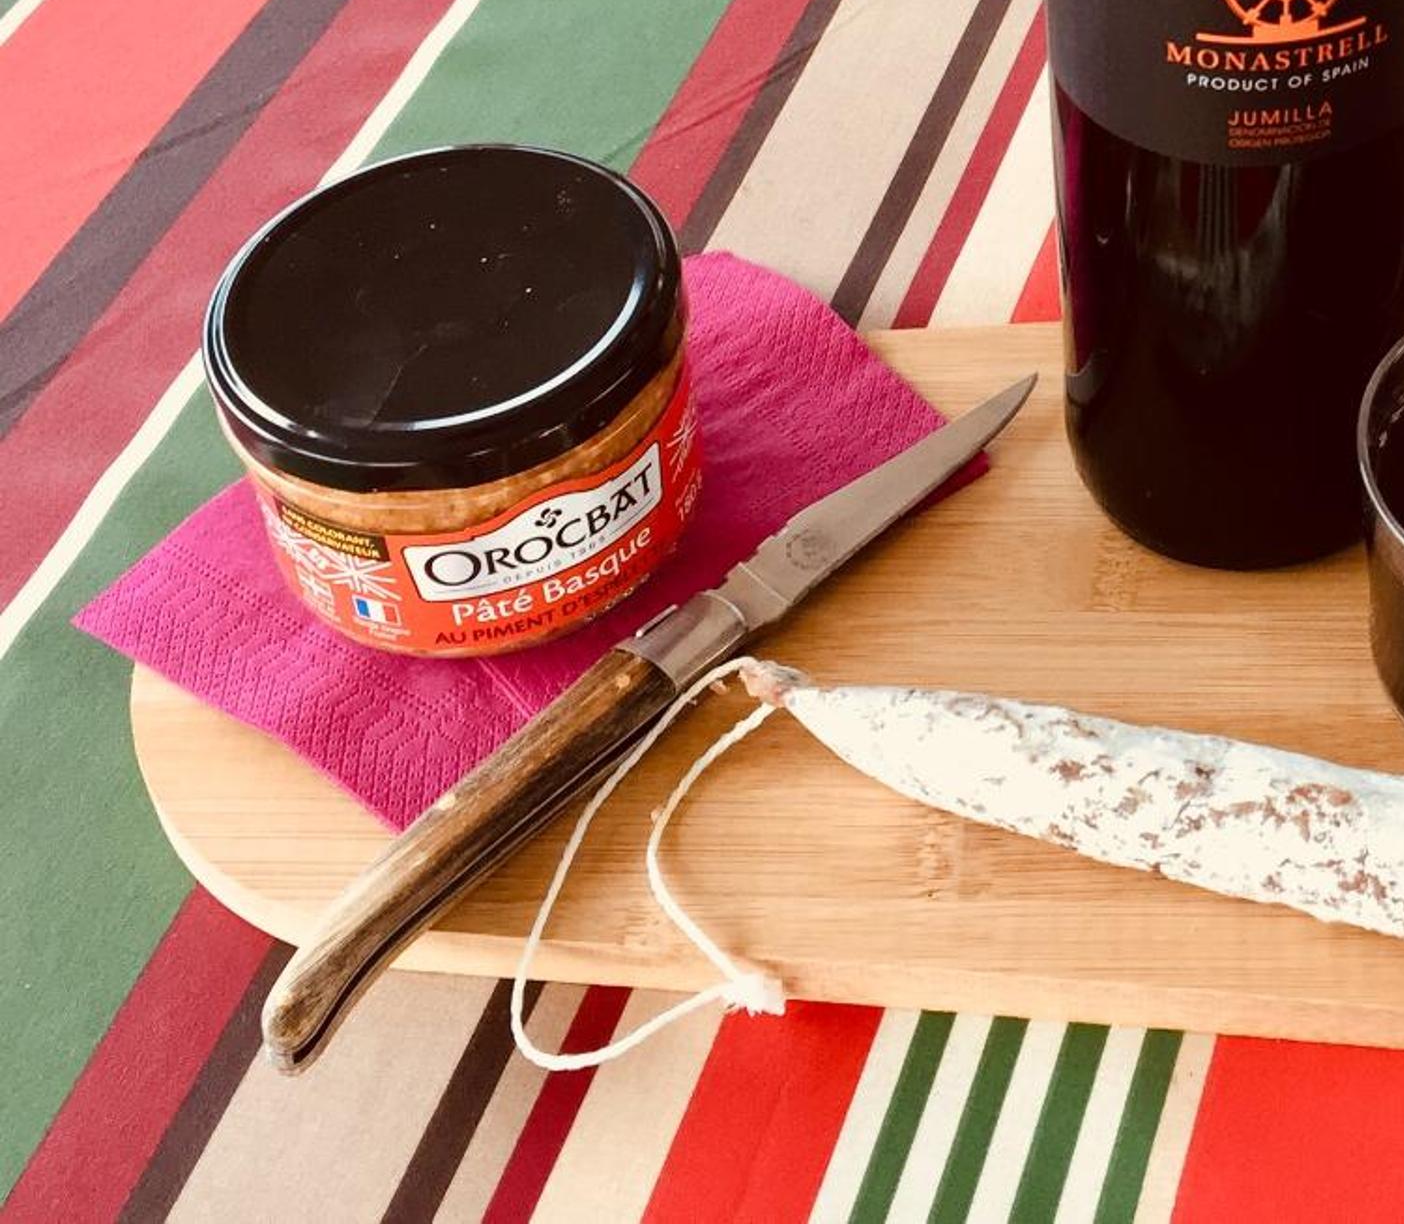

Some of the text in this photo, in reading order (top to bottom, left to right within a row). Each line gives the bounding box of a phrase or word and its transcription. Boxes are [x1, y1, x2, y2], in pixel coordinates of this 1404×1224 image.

[1165, 25, 1388, 72] MONASTRELL
[1186, 56, 1370, 92] PRODUCT OF SPAIN
[1226, 100, 1333, 127] JUMILLA
[423, 461, 653, 587] OROCBAT
[452, 526, 652, 626] Pâté Basque
[435, 630, 466, 645] AU
[473, 608, 556, 642] PIMENT
